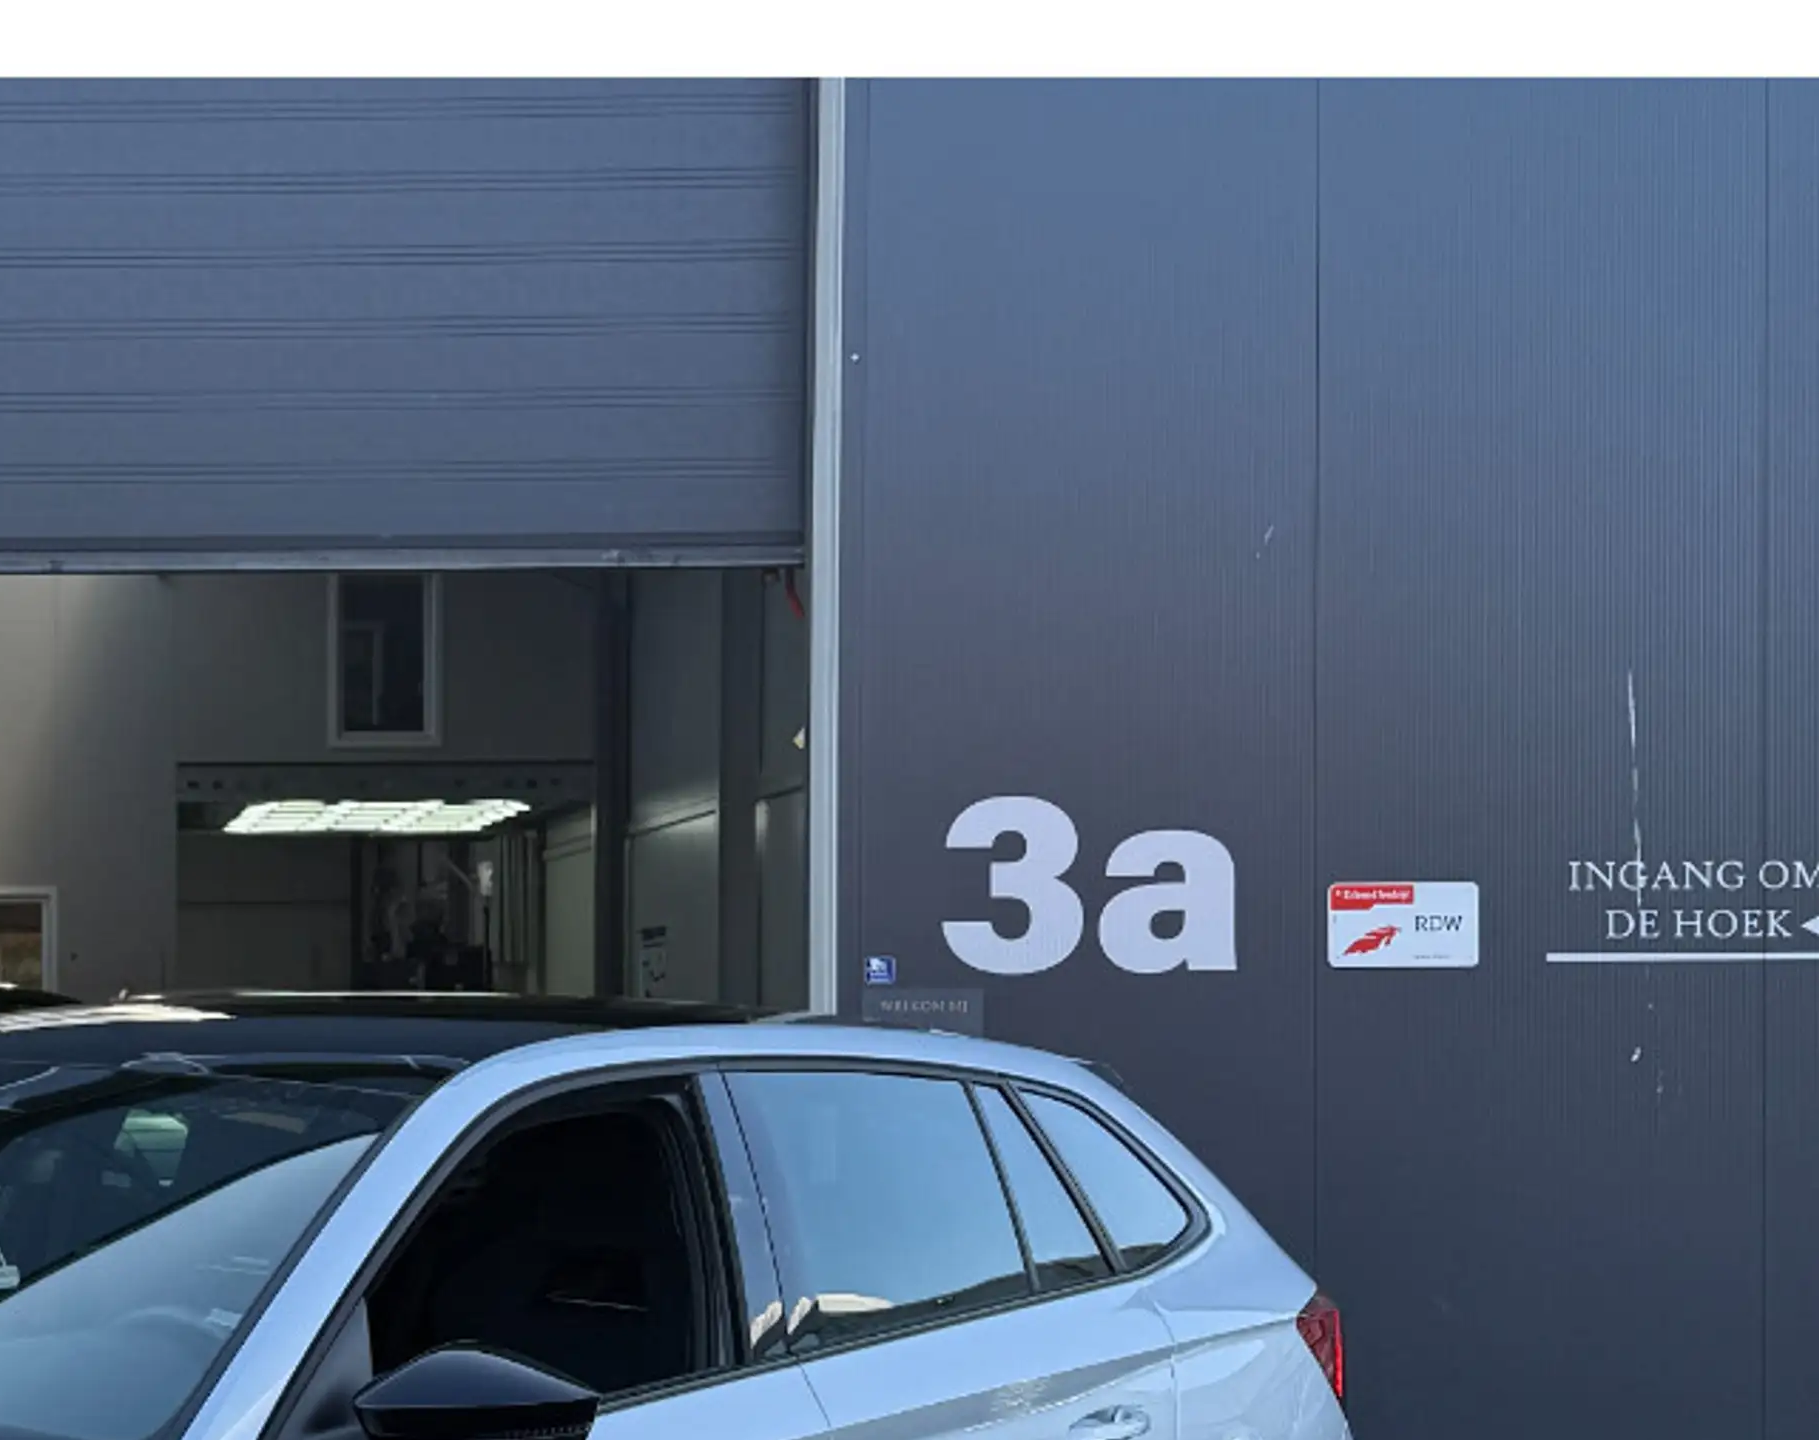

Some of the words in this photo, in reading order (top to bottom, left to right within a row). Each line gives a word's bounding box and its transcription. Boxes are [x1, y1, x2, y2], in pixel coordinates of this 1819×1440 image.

[940, 795, 1238, 975] 3a
[1568, 860, 1745, 891] INGANG
[1414, 915, 1463, 932] RDW
[1605, 909, 1660, 940] DE
[1673, 909, 1793, 940] HOEK
